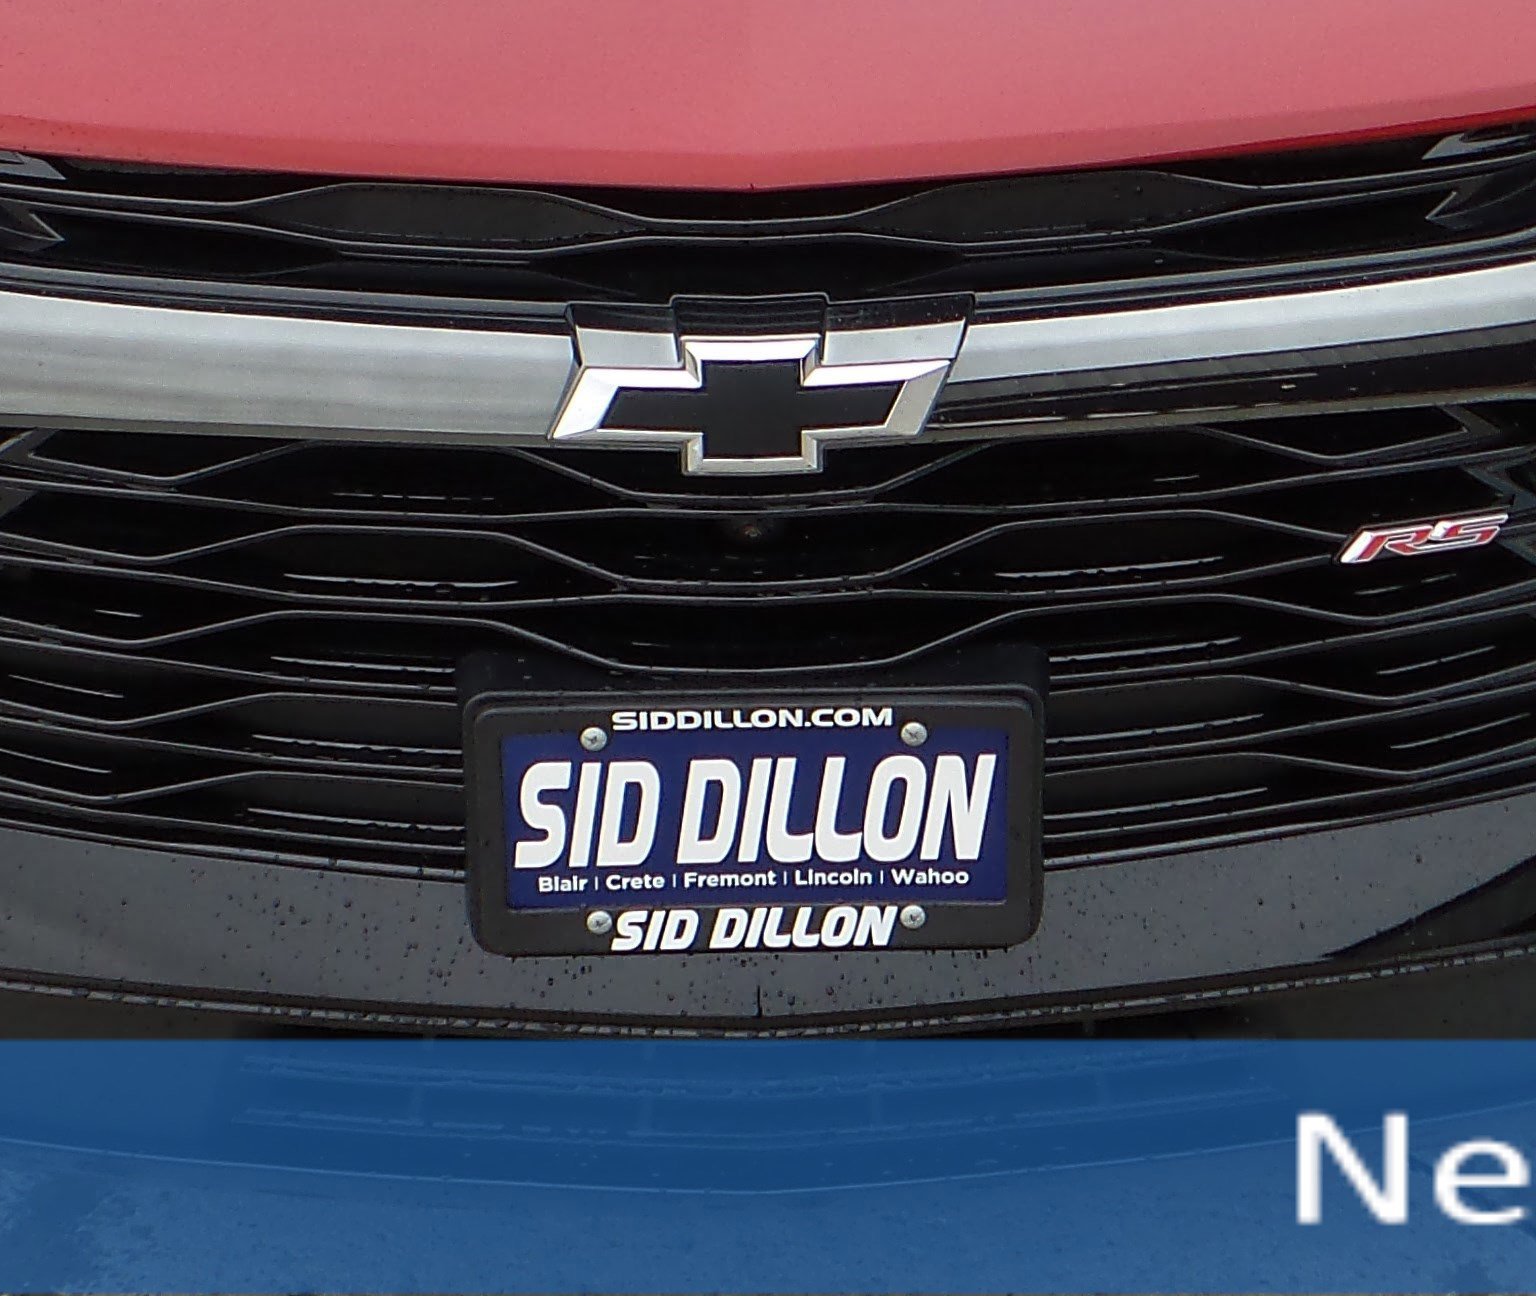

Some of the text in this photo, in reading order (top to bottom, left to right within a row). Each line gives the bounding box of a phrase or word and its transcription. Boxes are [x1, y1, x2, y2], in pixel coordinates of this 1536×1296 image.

[1339, 512, 1509, 564] RS
[611, 707, 894, 732] SIDDILLON.COM
[514, 753, 998, 869] SID DILLON
[538, 868, 970, 893] Blair Crete Fremont Lincoln Wahoo
[610, 904, 899, 951] SID DILLON
